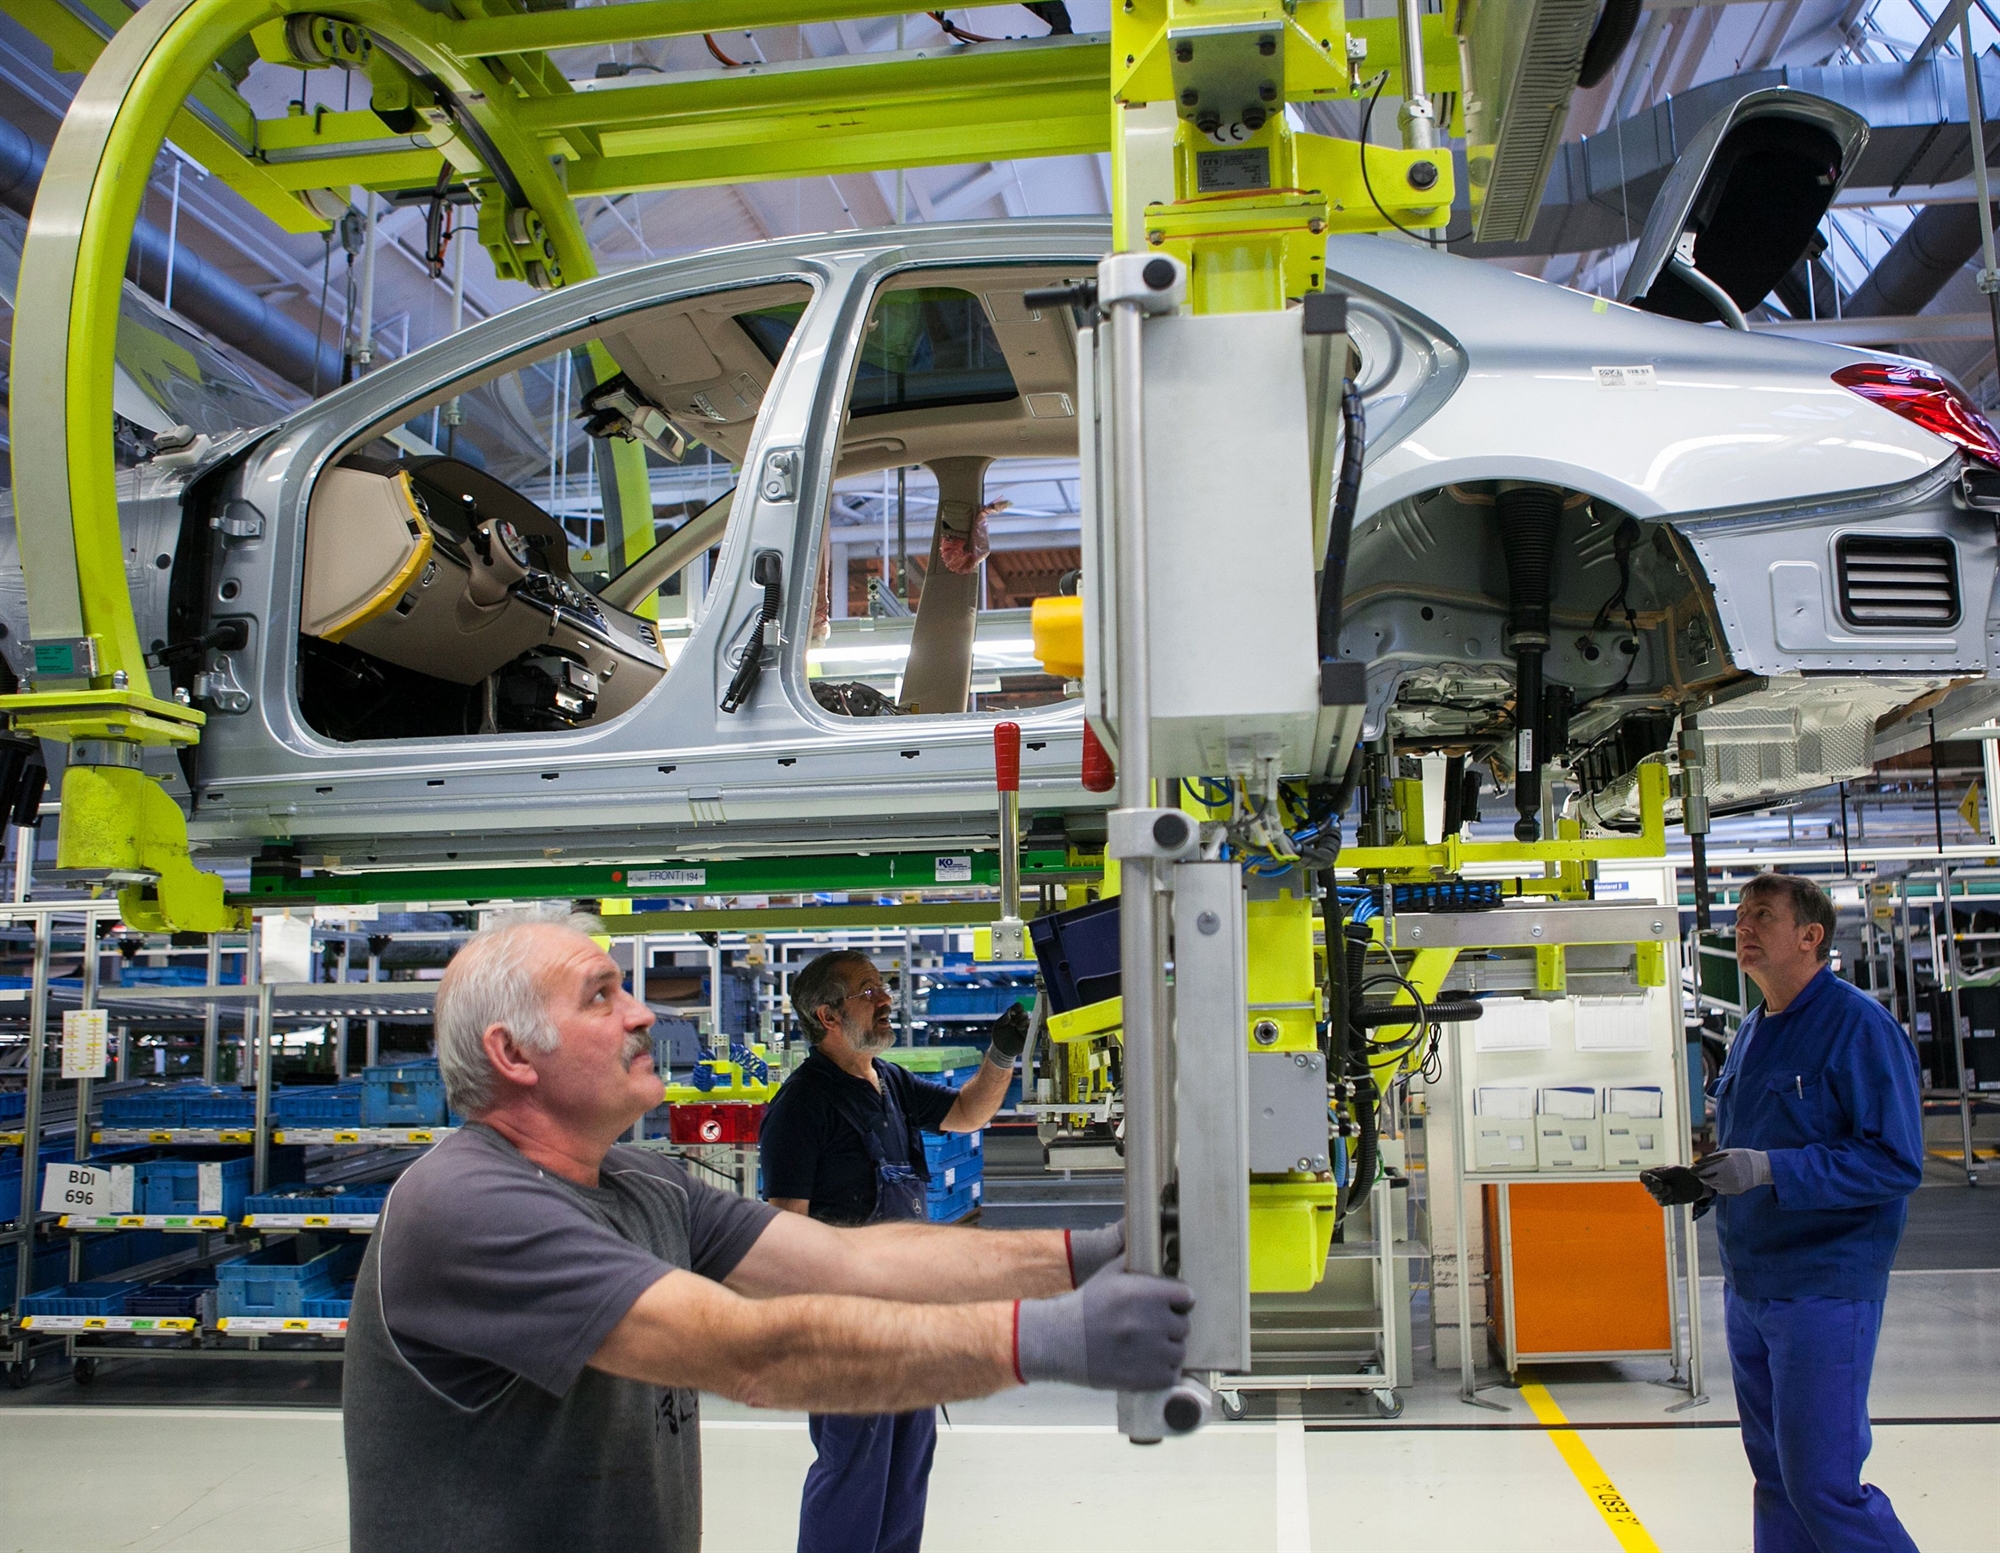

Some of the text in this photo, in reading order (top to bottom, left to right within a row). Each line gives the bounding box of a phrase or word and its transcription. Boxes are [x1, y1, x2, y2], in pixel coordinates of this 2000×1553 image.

[1214, 122, 1244, 142] CE
[1968, 801, 1974, 818] 7
[938, 858, 954, 868] KO
[649, 870, 681, 881] FRONT
[686, 872, 699, 882] 194
[68, 1170, 96, 1186] BDI
[65, 1189, 94, 1205] 696
[1597, 1493, 1631, 1513] ESD
